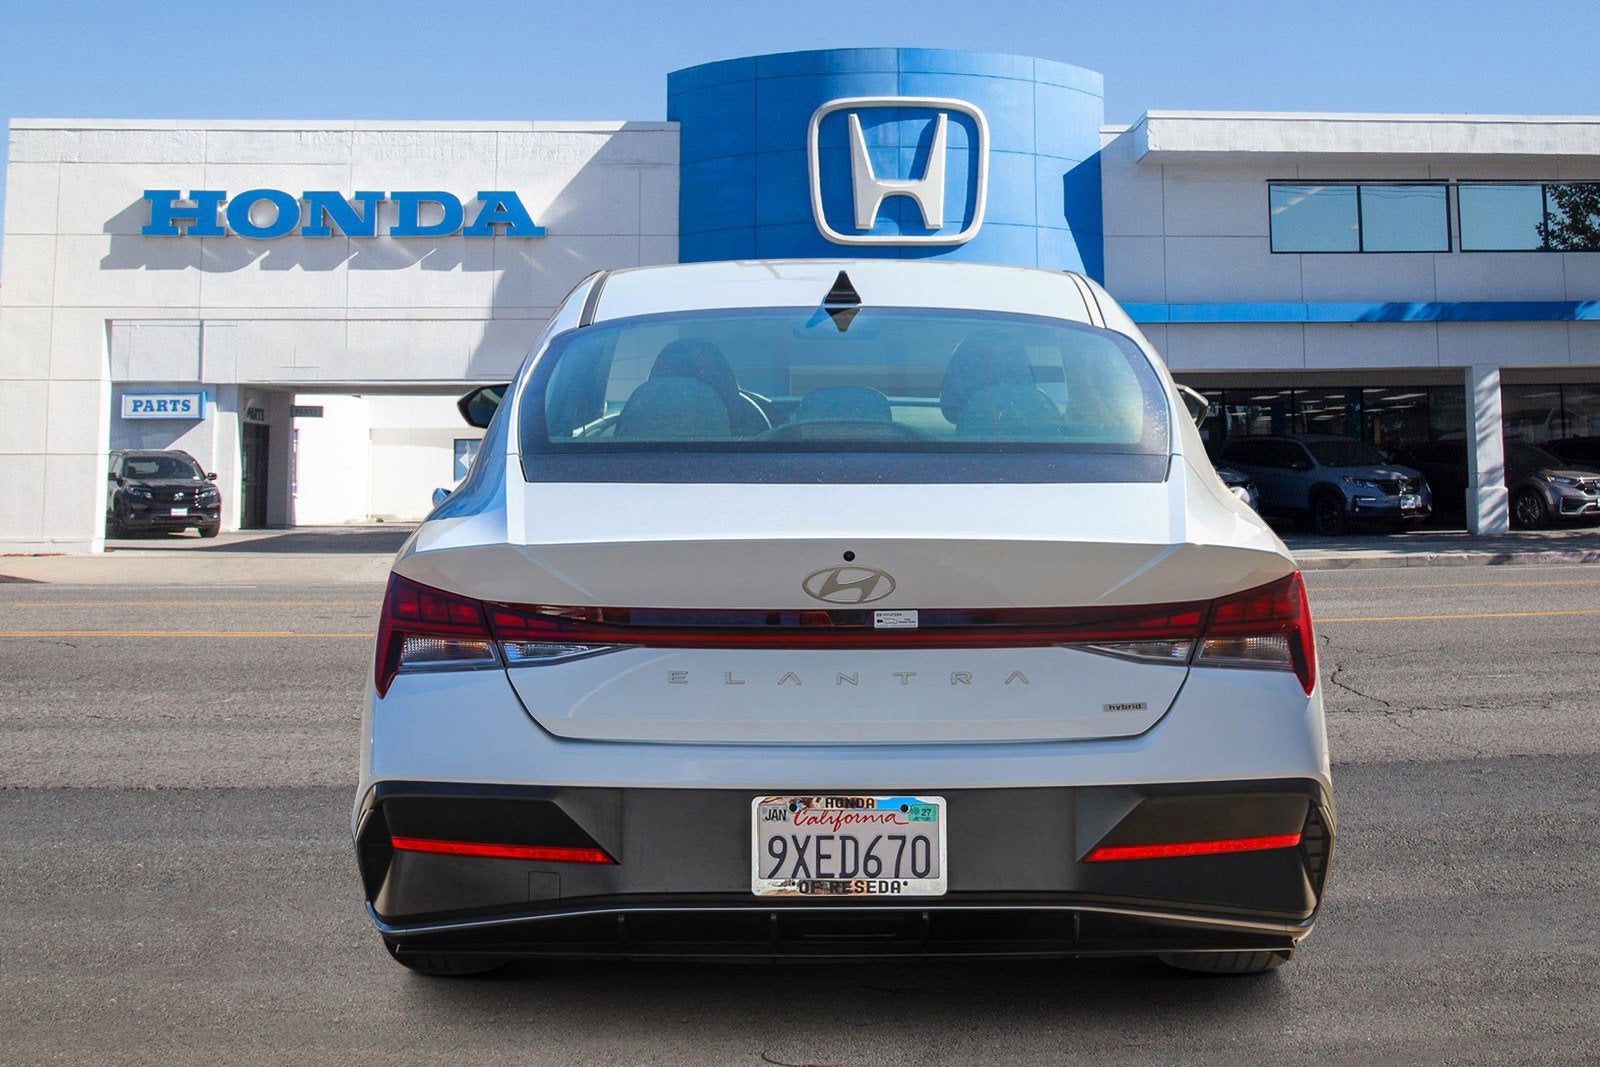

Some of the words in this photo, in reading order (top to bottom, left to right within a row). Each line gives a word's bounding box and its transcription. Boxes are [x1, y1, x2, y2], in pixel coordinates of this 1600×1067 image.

[142, 189, 548, 240] HONDA
[132, 400, 191, 412] PARTS
[668, 671, 1030, 685] ELANTRA
[1109, 703, 1142, 711] hybrid
[825, 798, 875, 808] HONDA
[765, 808, 786, 821] JAN
[921, 808, 932, 816] 27
[793, 809, 909, 832] California
[767, 835, 931, 878] 9XED670
[829, 881, 901, 894] RESEDA
